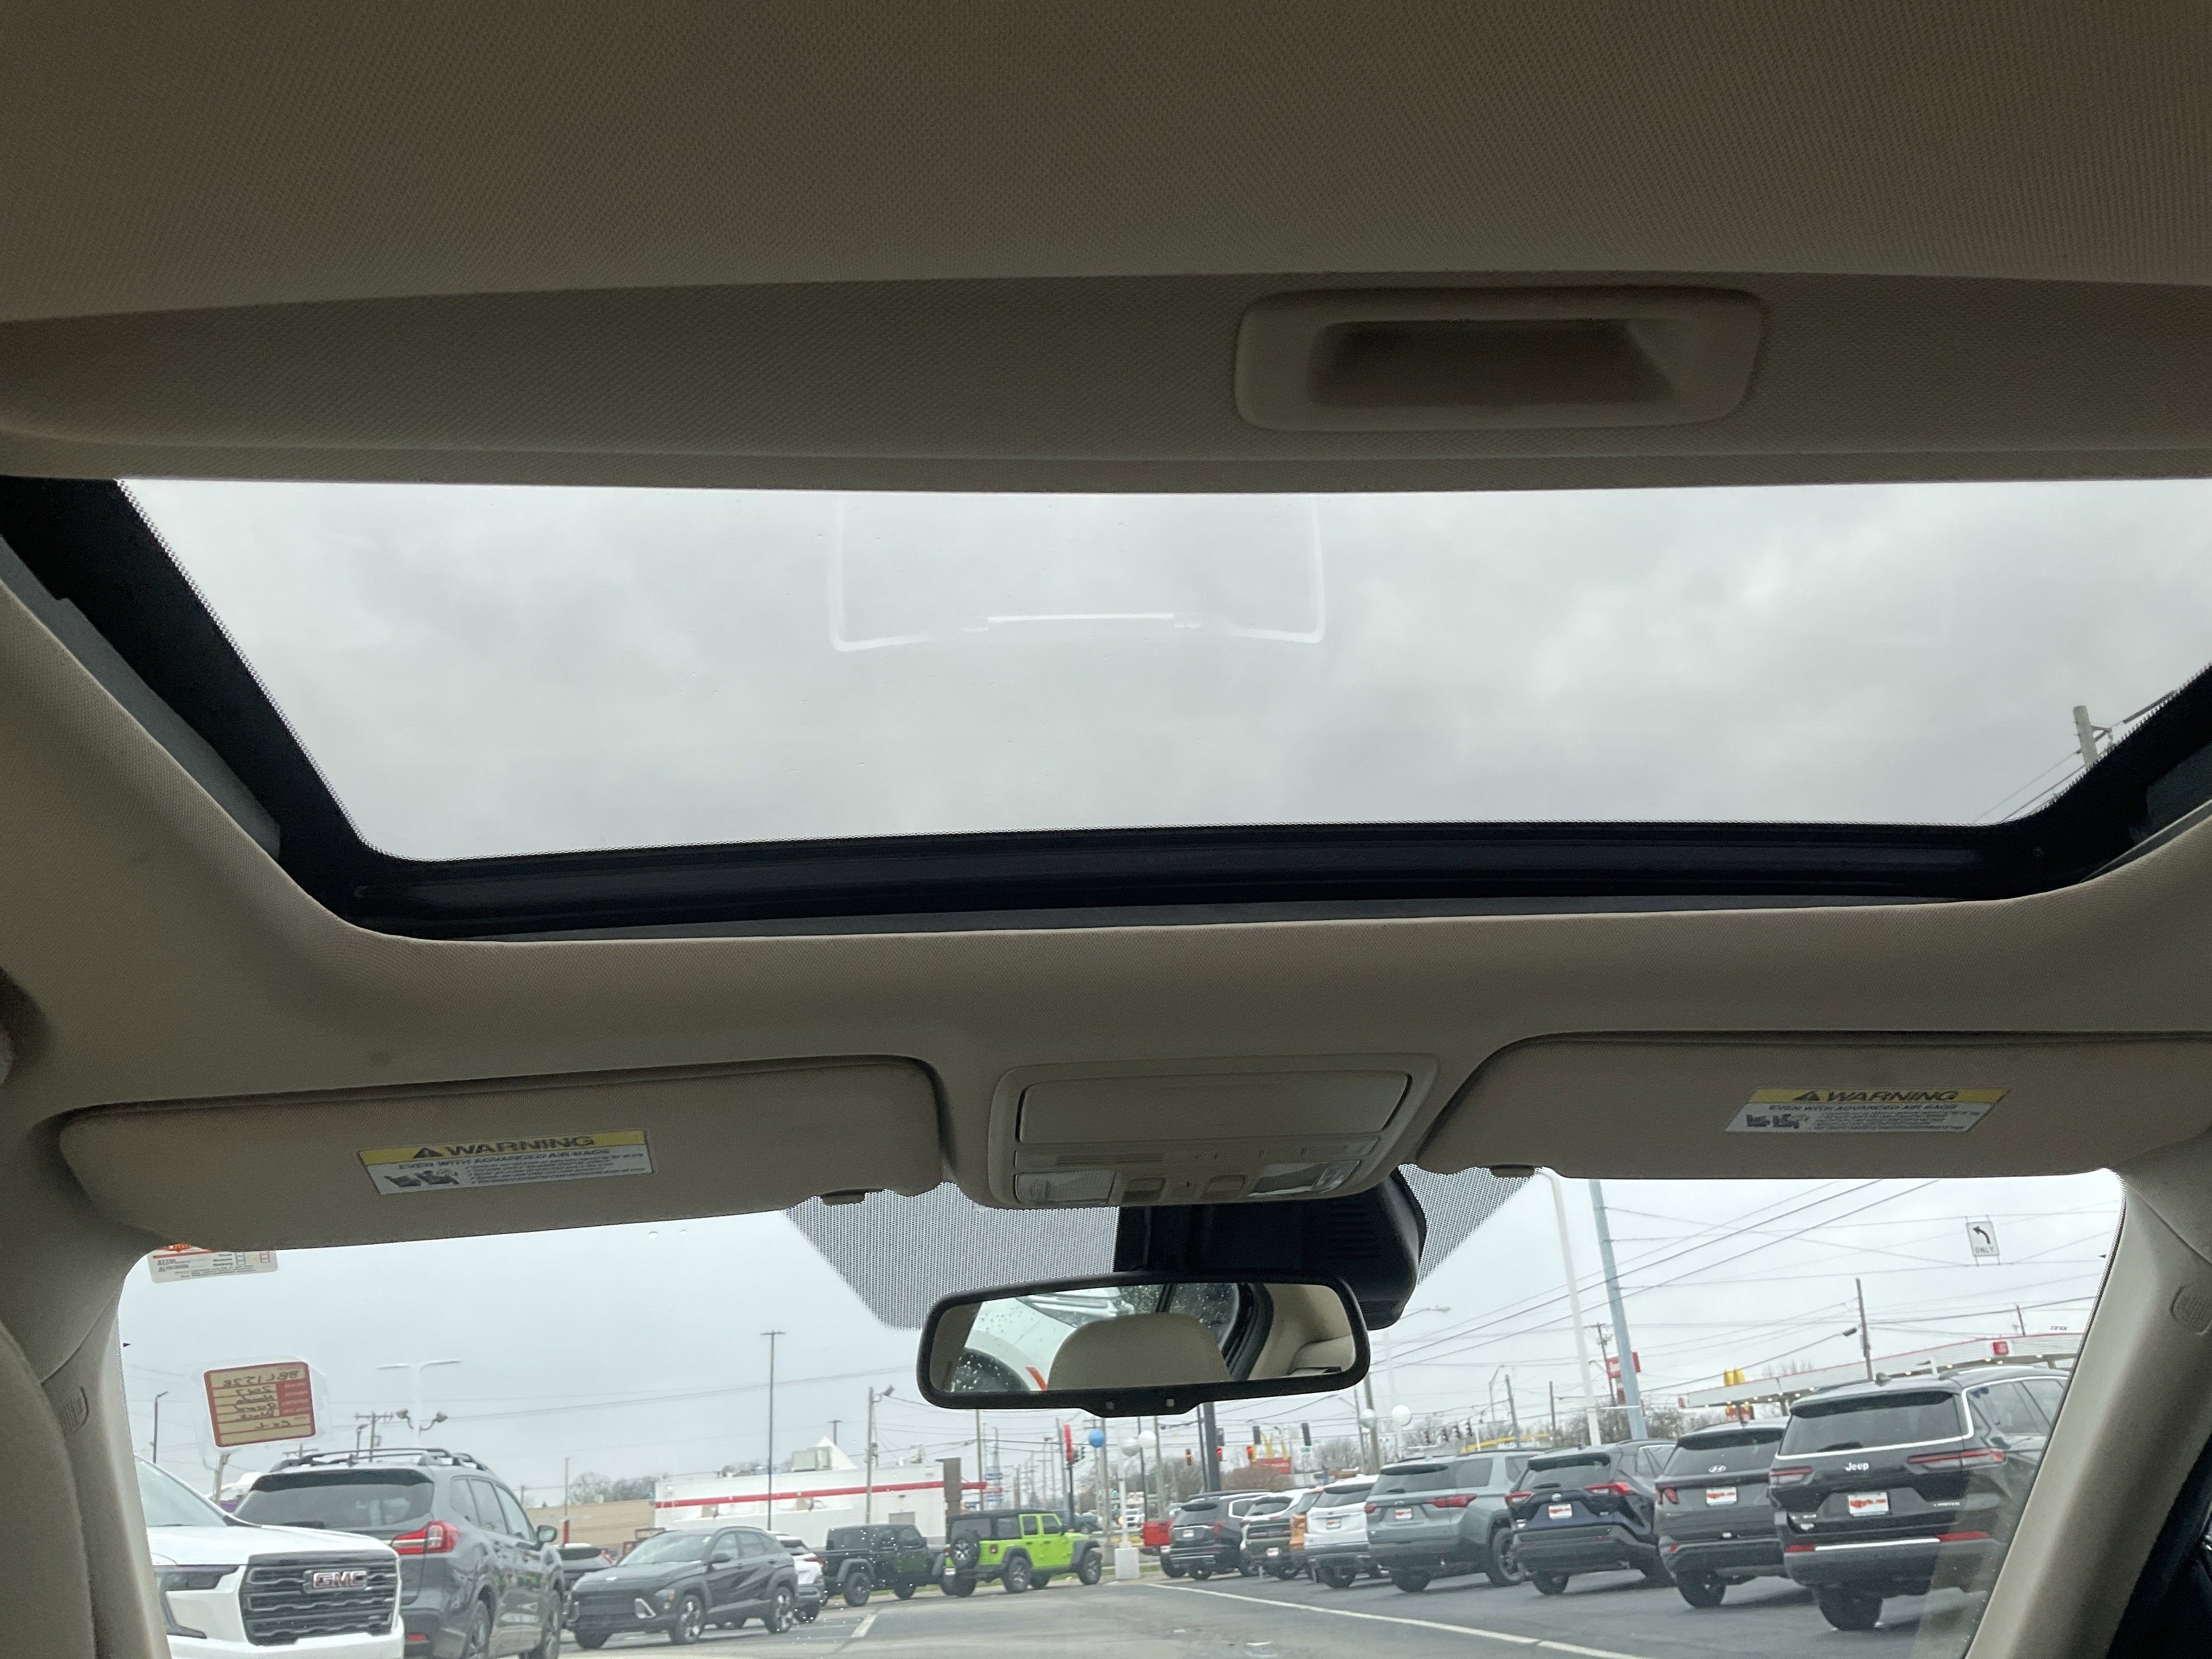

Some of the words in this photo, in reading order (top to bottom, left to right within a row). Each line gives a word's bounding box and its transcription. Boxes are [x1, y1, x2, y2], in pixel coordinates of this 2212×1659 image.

[1827, 1090, 1960, 1102] WARNING
[445, 1135, 596, 1156] WARNING
[1844, 1462, 1869, 1471] Jeep
[313, 1570, 367, 1588] GMC
